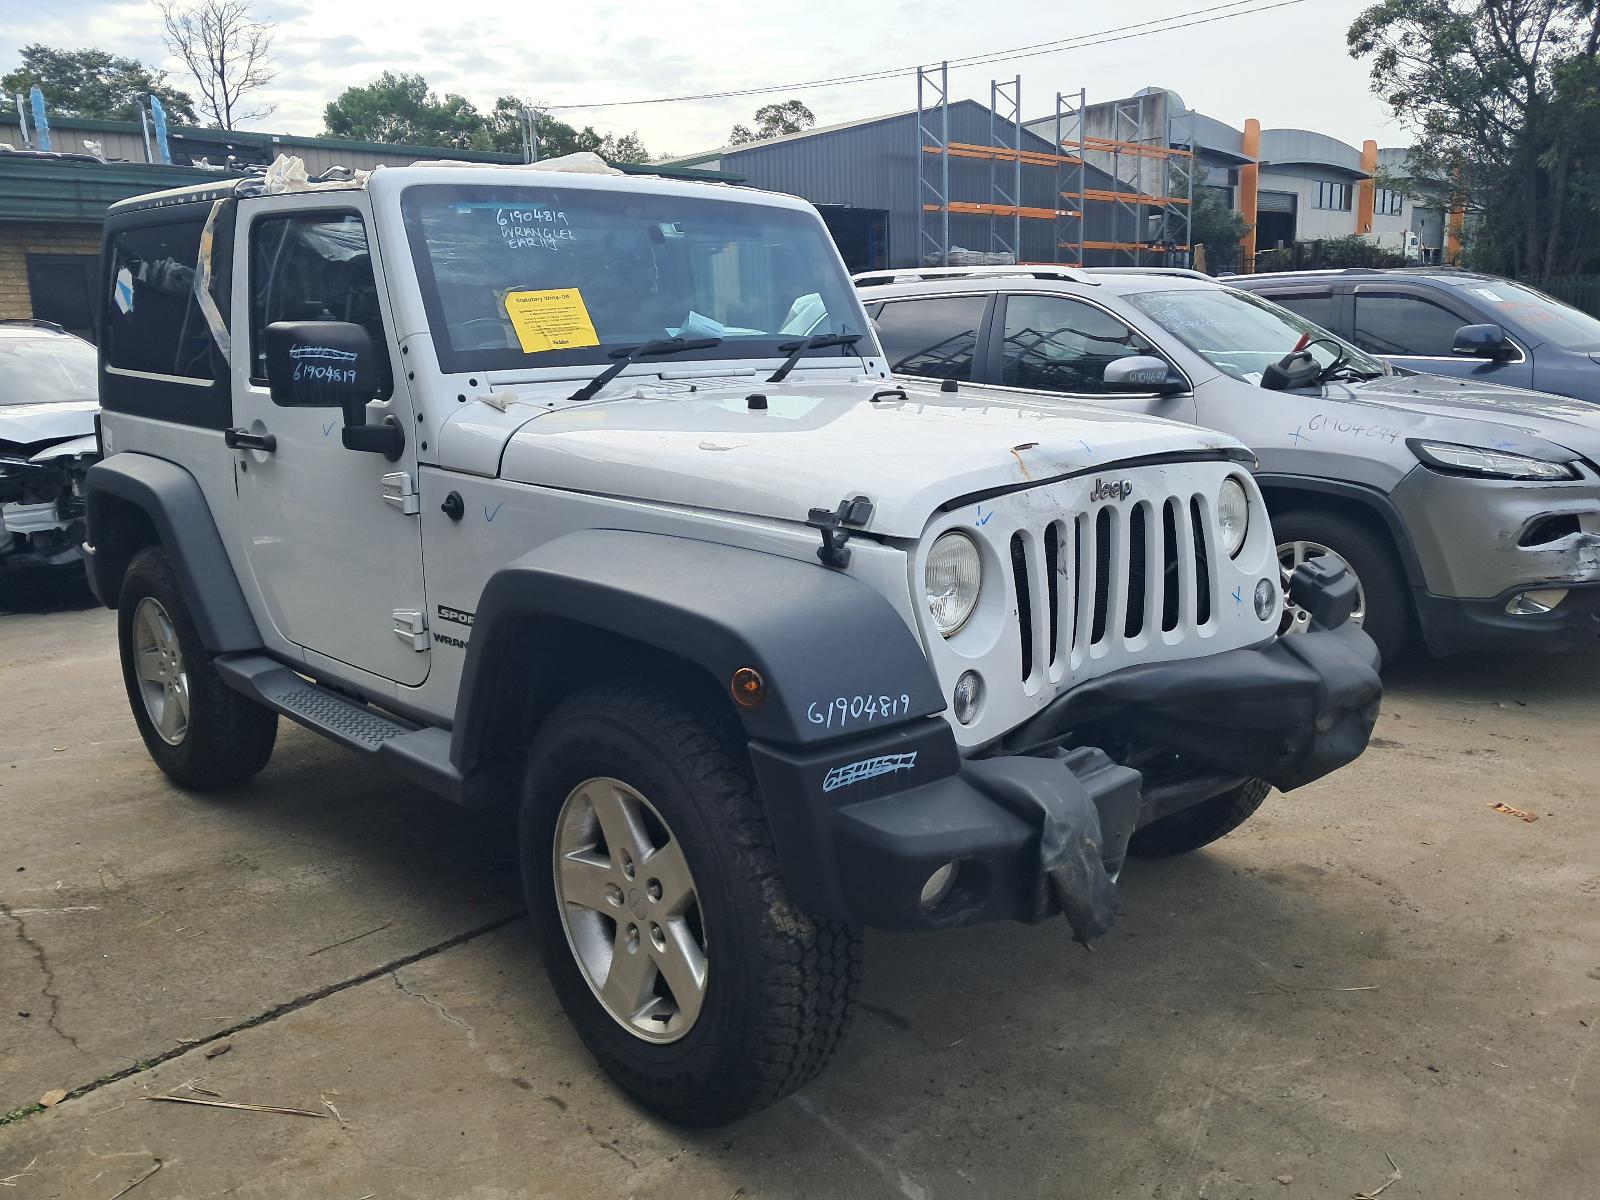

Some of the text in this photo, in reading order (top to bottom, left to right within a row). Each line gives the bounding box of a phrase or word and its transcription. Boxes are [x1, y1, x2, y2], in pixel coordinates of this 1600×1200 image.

[497, 208, 568, 226] 61904819
[294, 362, 357, 384] 61904819
[1090, 478, 1133, 502] Jeep
[808, 694, 910, 728] 61904819
